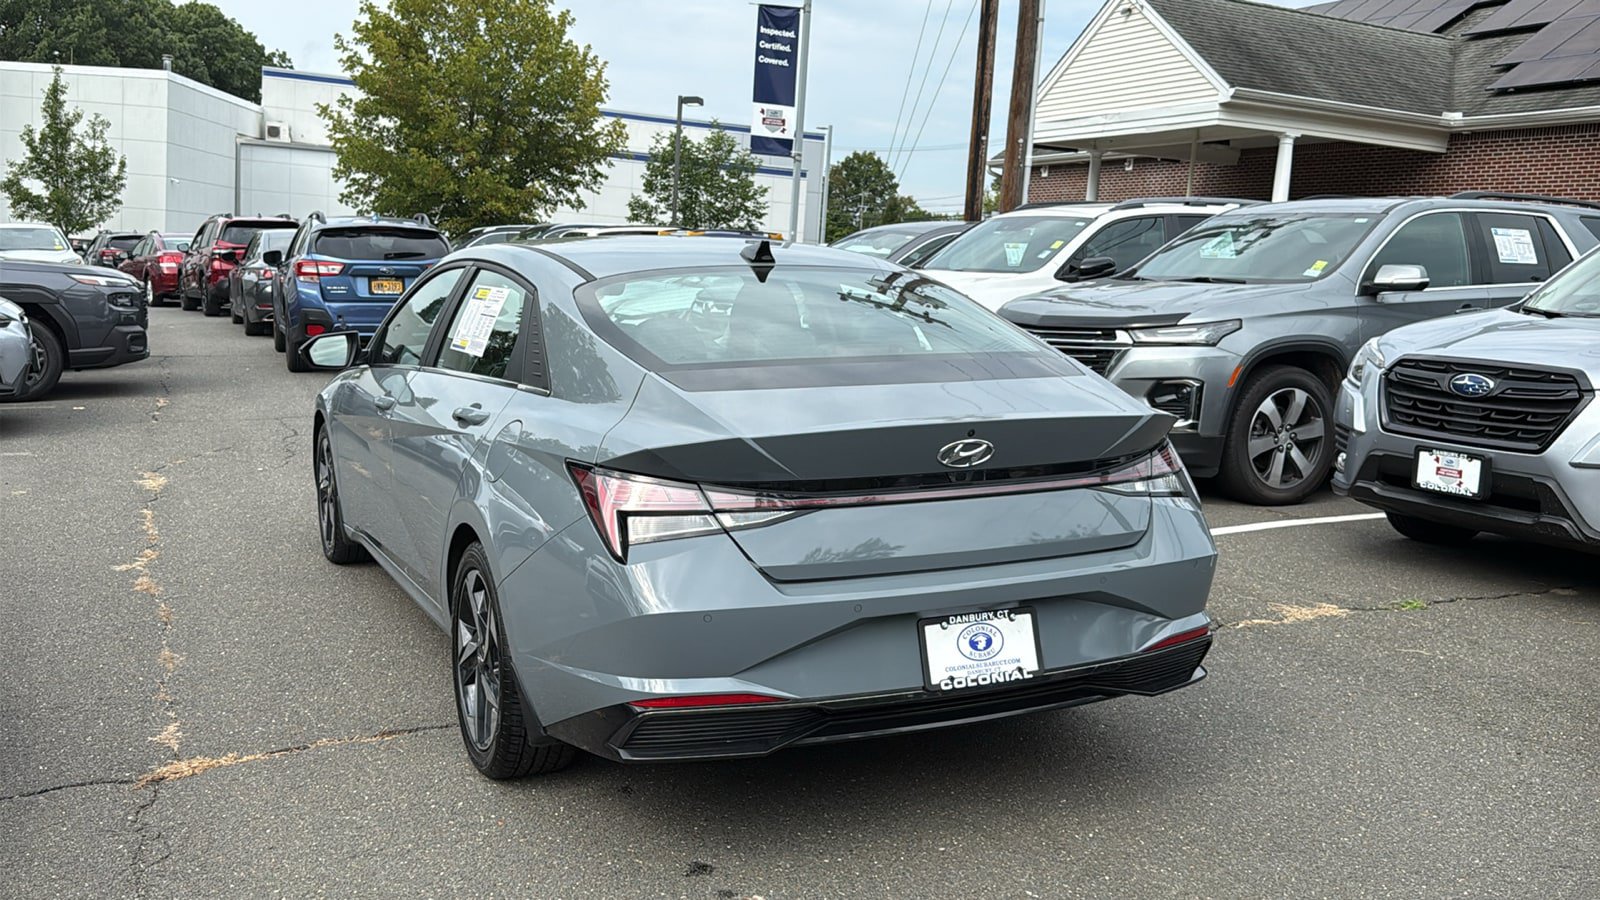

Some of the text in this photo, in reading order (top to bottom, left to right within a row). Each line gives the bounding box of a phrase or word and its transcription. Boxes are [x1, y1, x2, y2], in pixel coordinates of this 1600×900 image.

[760, 26, 796, 38] Inspected.
[759, 40, 791, 52] Certified.
[758, 55, 789, 66] Covered.
[1420, 481, 1472, 496] COLONIAL
[997, 610, 1009, 619] CT
[962, 625, 998, 640] COLONIAL
[969, 648, 996, 659] SUBARU
[940, 669, 1033, 691] COLONIAL
